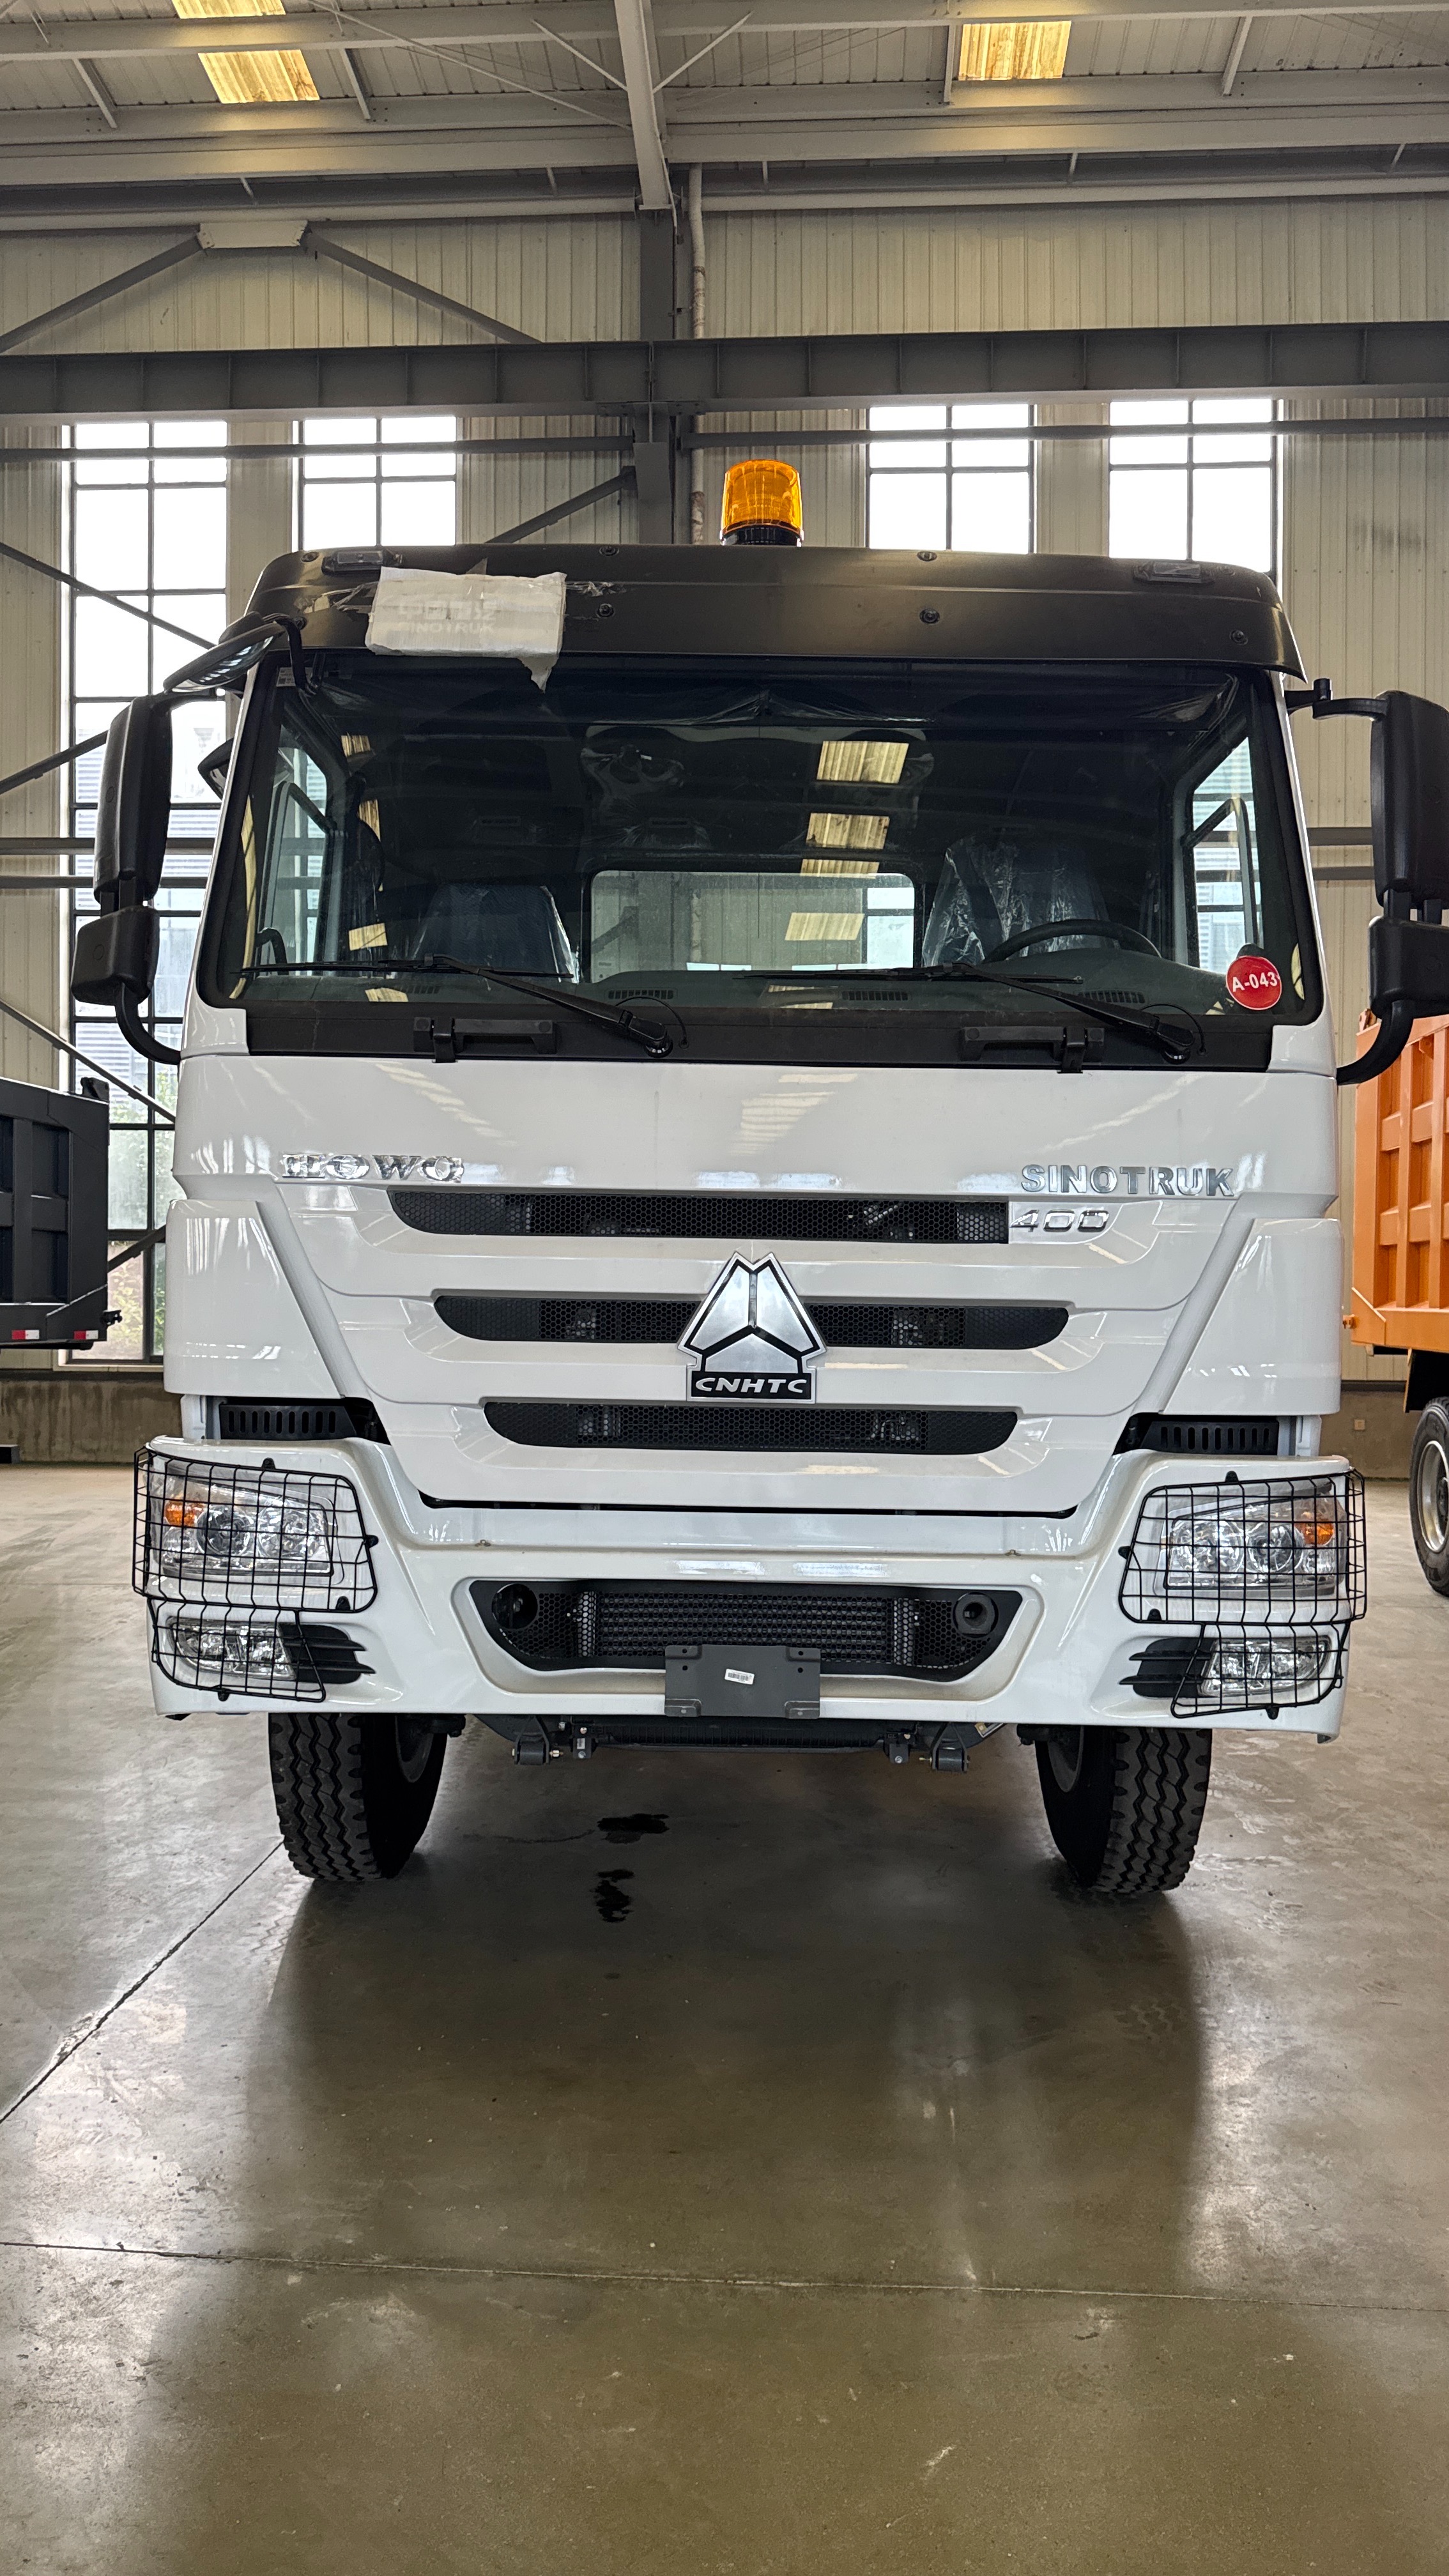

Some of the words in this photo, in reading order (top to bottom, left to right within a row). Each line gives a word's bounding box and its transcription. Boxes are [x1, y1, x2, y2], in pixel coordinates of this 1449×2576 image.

[1232, 971, 1278, 992] A-043
[282, 1154, 464, 1181] HOWO
[1020, 1164, 1234, 1197] SINOTRUK
[1010, 1209, 1110, 1232] 400
[695, 1377, 808, 1393] CNHTC
